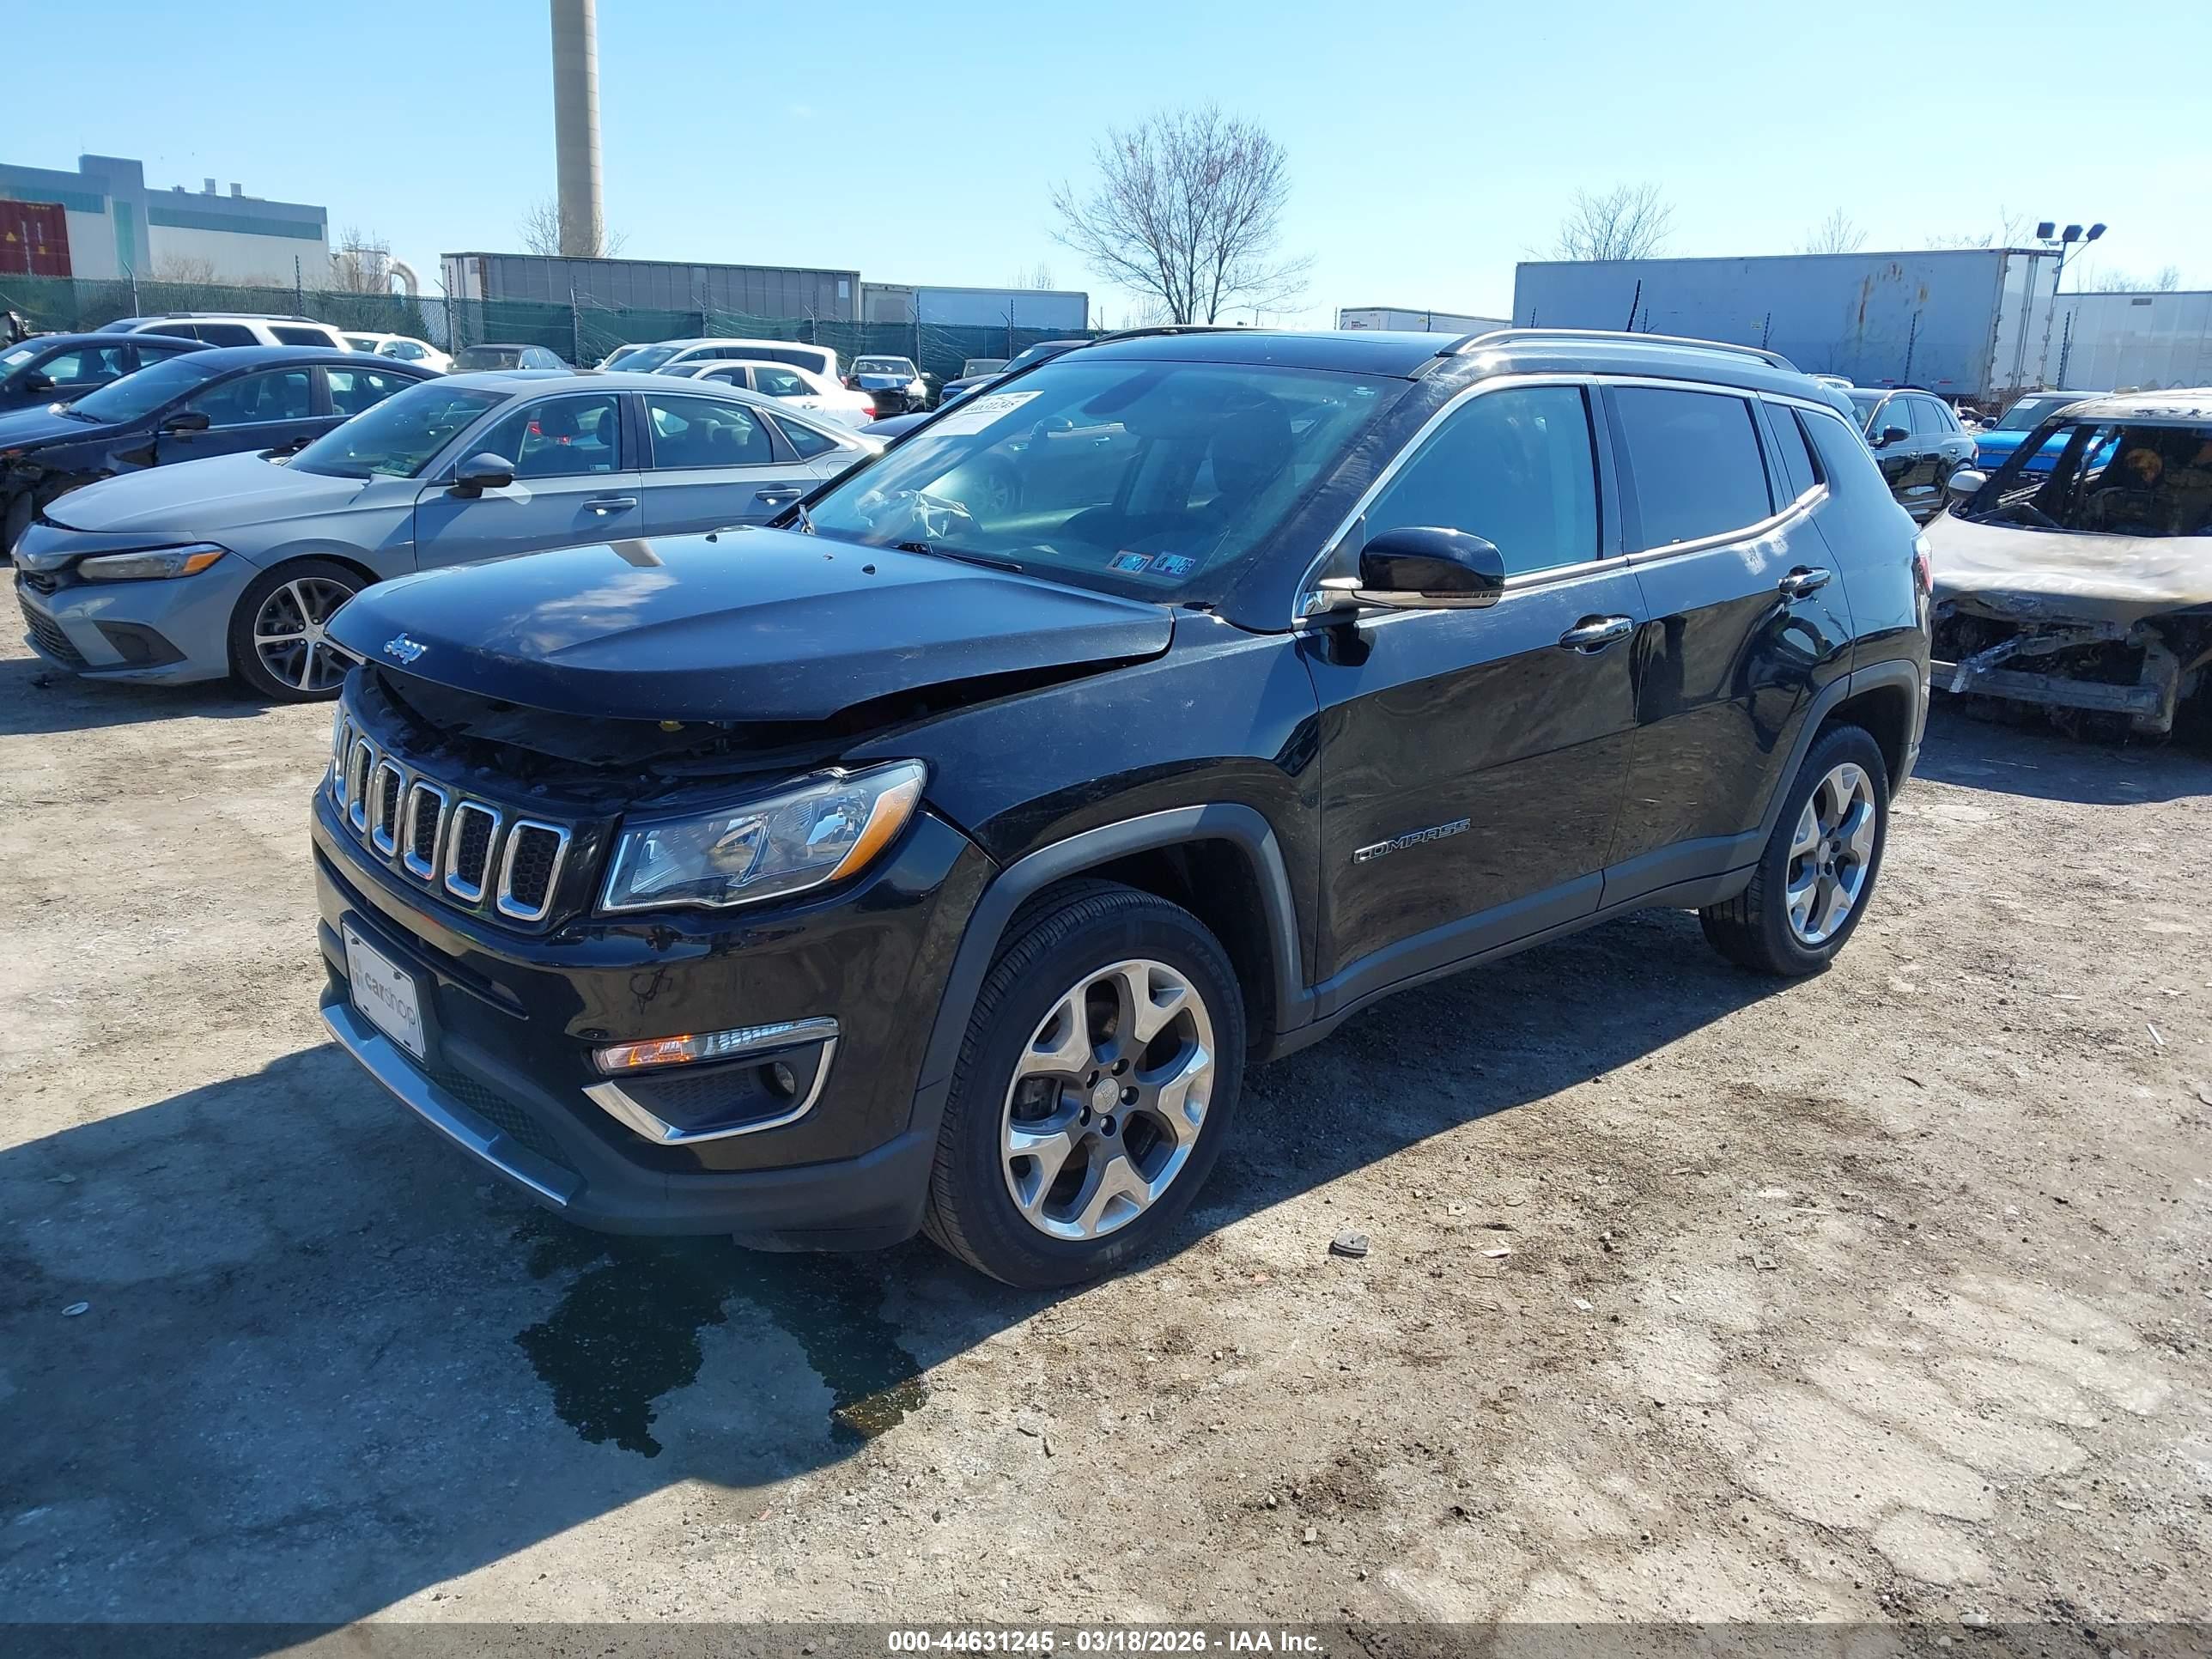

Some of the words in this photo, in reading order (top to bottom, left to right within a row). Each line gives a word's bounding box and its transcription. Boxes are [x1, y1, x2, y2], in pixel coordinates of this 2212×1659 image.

[383, 632, 428, 665] Jeep
[1353, 818, 1471, 864] COMPASS
[364, 972, 416, 1029] carshop
